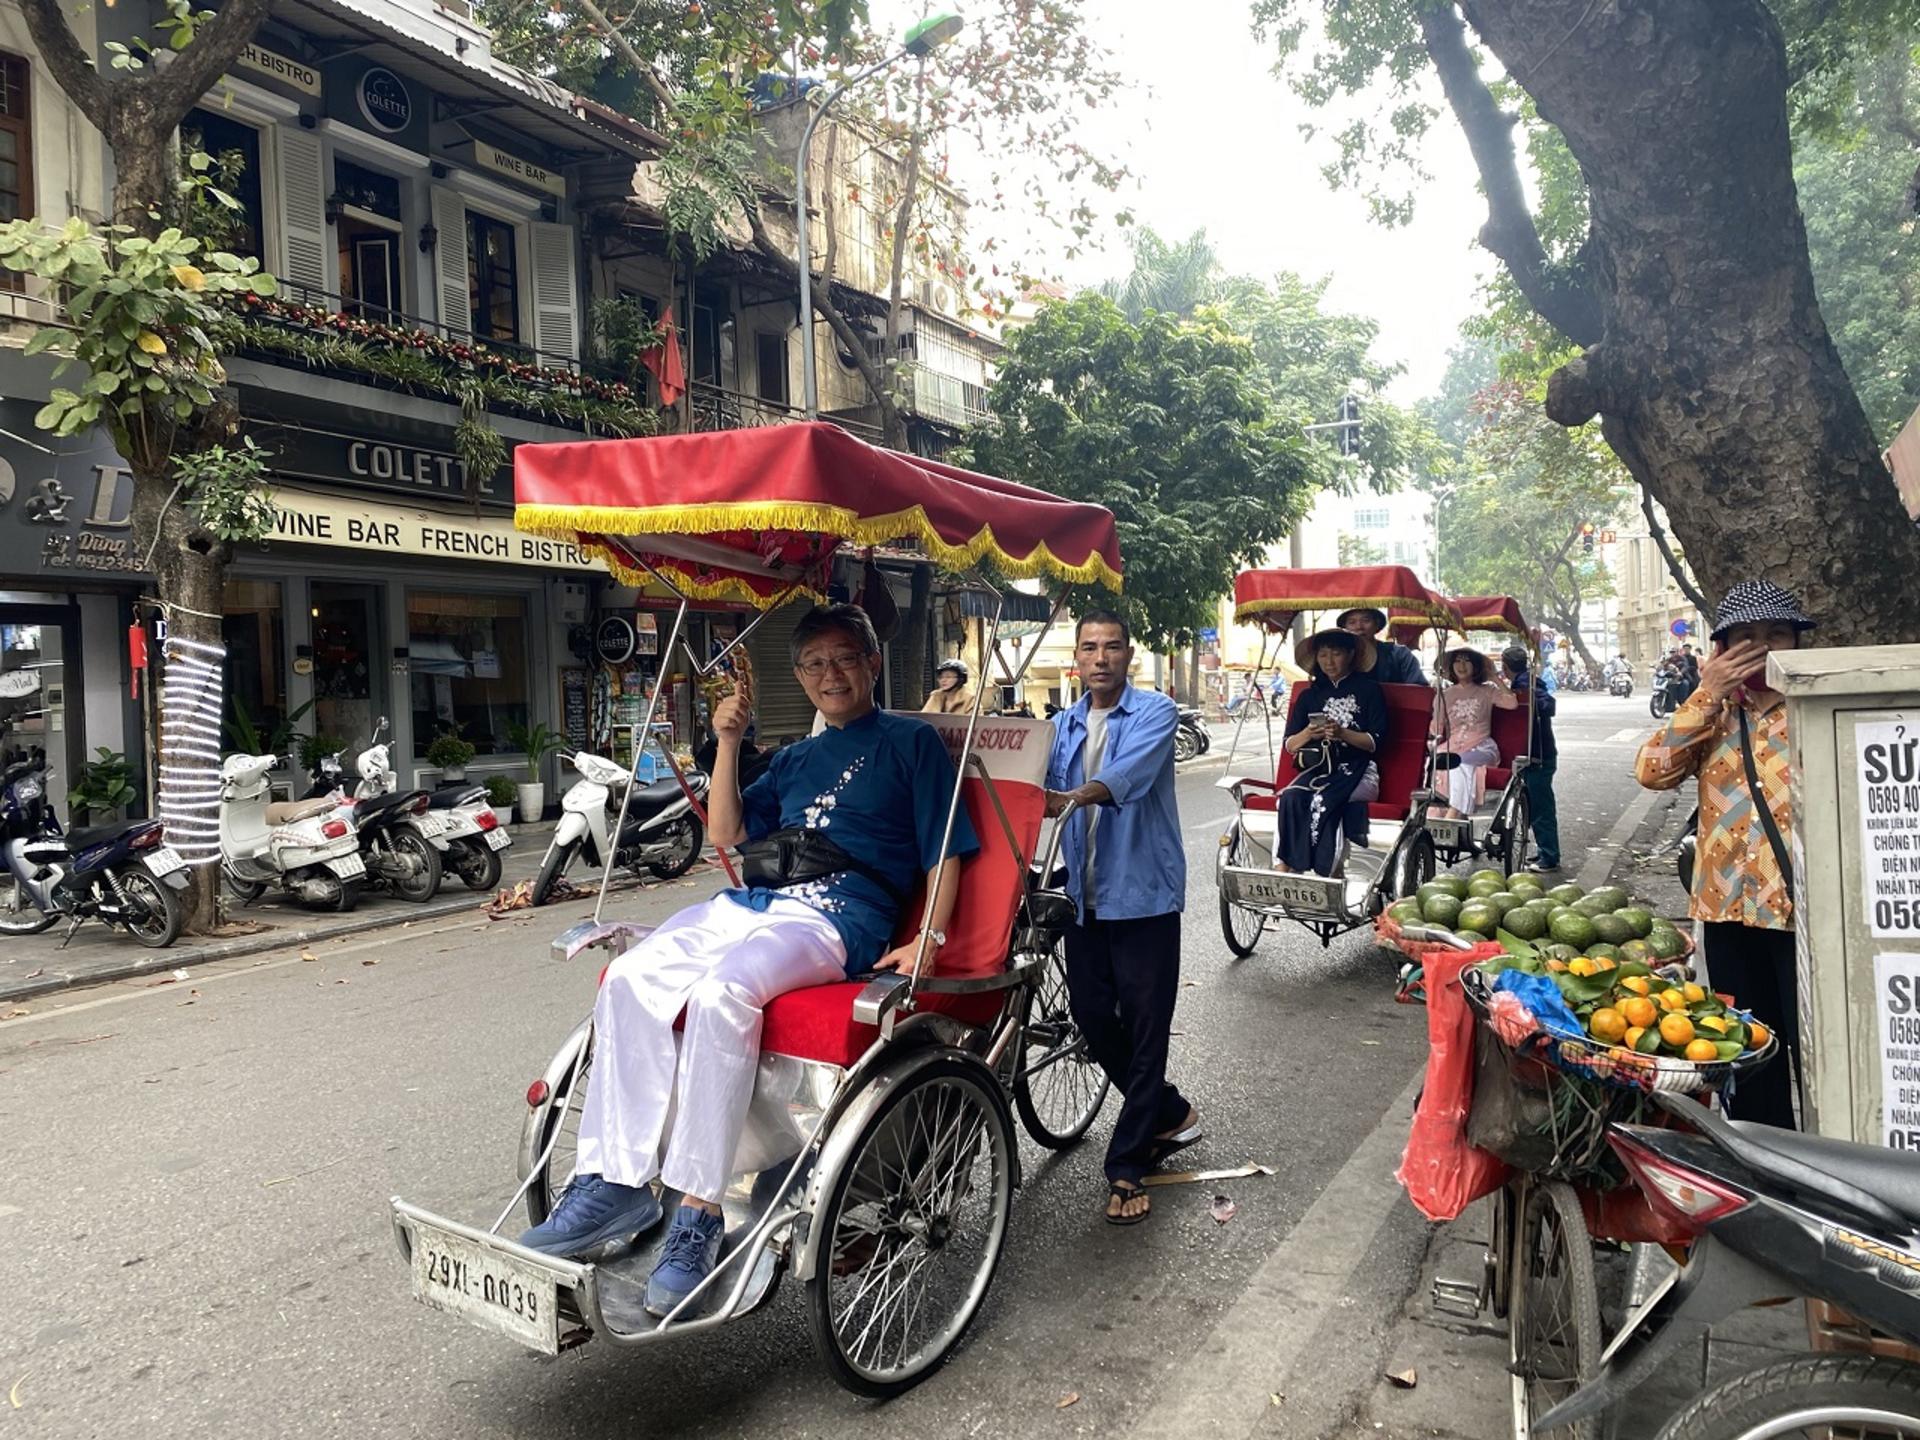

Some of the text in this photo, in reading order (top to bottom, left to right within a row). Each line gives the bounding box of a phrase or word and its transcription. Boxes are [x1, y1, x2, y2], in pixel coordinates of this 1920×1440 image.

[261, 52, 314, 86] BISTRO
[366, 91, 407, 118] COLETTE
[494, 152, 547, 185] WINE BAR
[348, 519, 401, 547] BAR
[421, 527, 509, 558] FRENCH
[75, 553, 152, 573] 0912345
[976, 727, 1031, 751] SOUCI
[1863, 725, 1920, 784] SỬ
[1868, 785, 1920, 814] 0589 40
[1247, 884, 1317, 903] 29XL-0166
[1876, 875, 1905, 899] NHẬN
[1889, 1016, 1920, 1045] 0589
[428, 1250, 537, 1323] 29XL-0039
